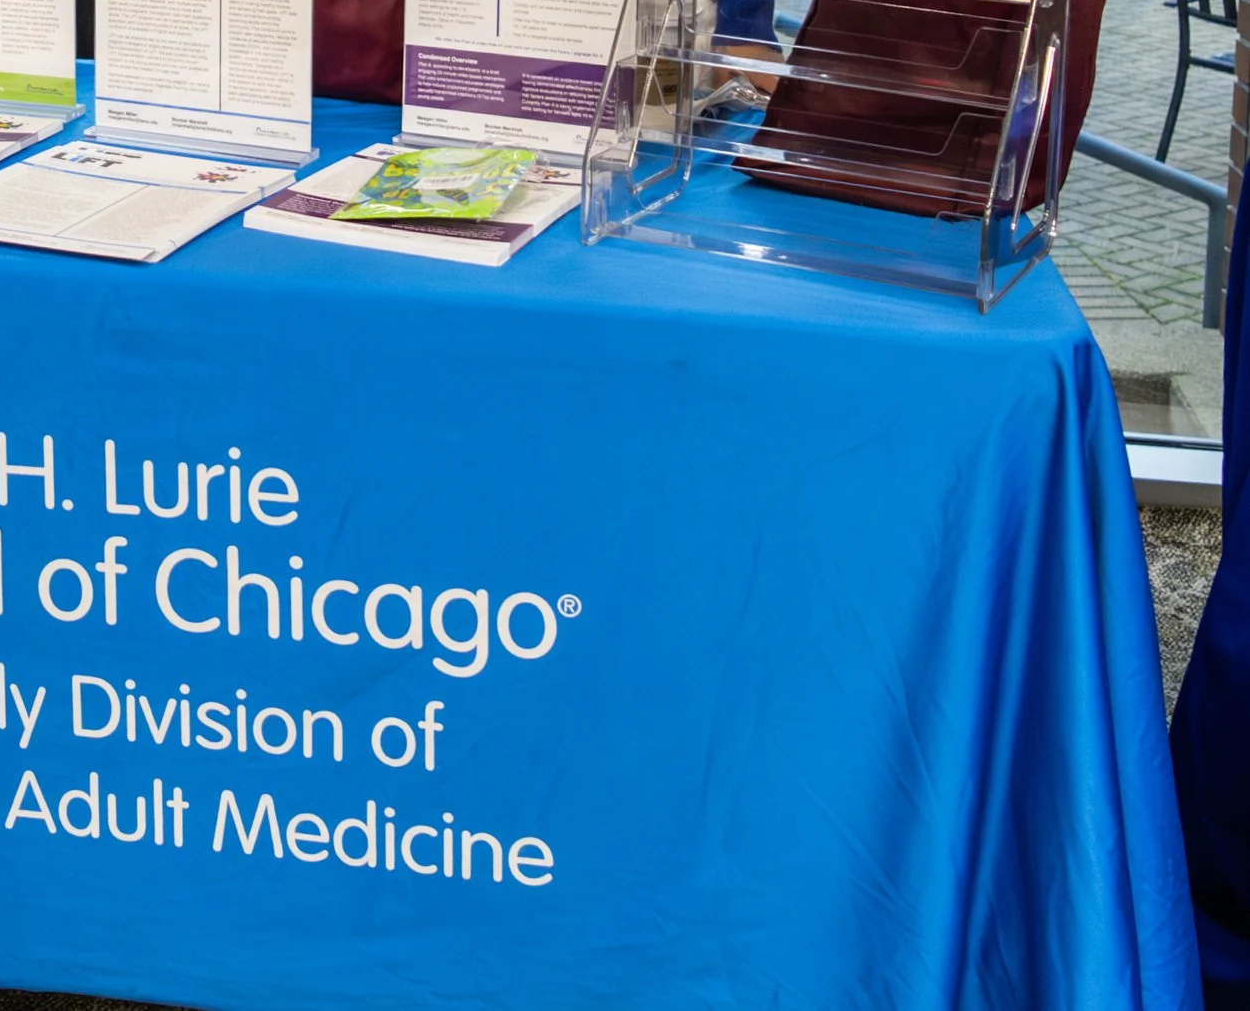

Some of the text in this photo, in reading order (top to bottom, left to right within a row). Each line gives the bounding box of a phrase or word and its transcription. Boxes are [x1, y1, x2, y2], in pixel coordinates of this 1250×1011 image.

[418, 53, 478, 65] Condensed Overview
[106, 440, 298, 525] Lurie
[39, 537, 127, 625] of
[72, 675, 342, 761] Division
[372, 701, 443, 770] of
[5, 771, 189, 846] Adult
[213, 790, 553, 885] Medicine
